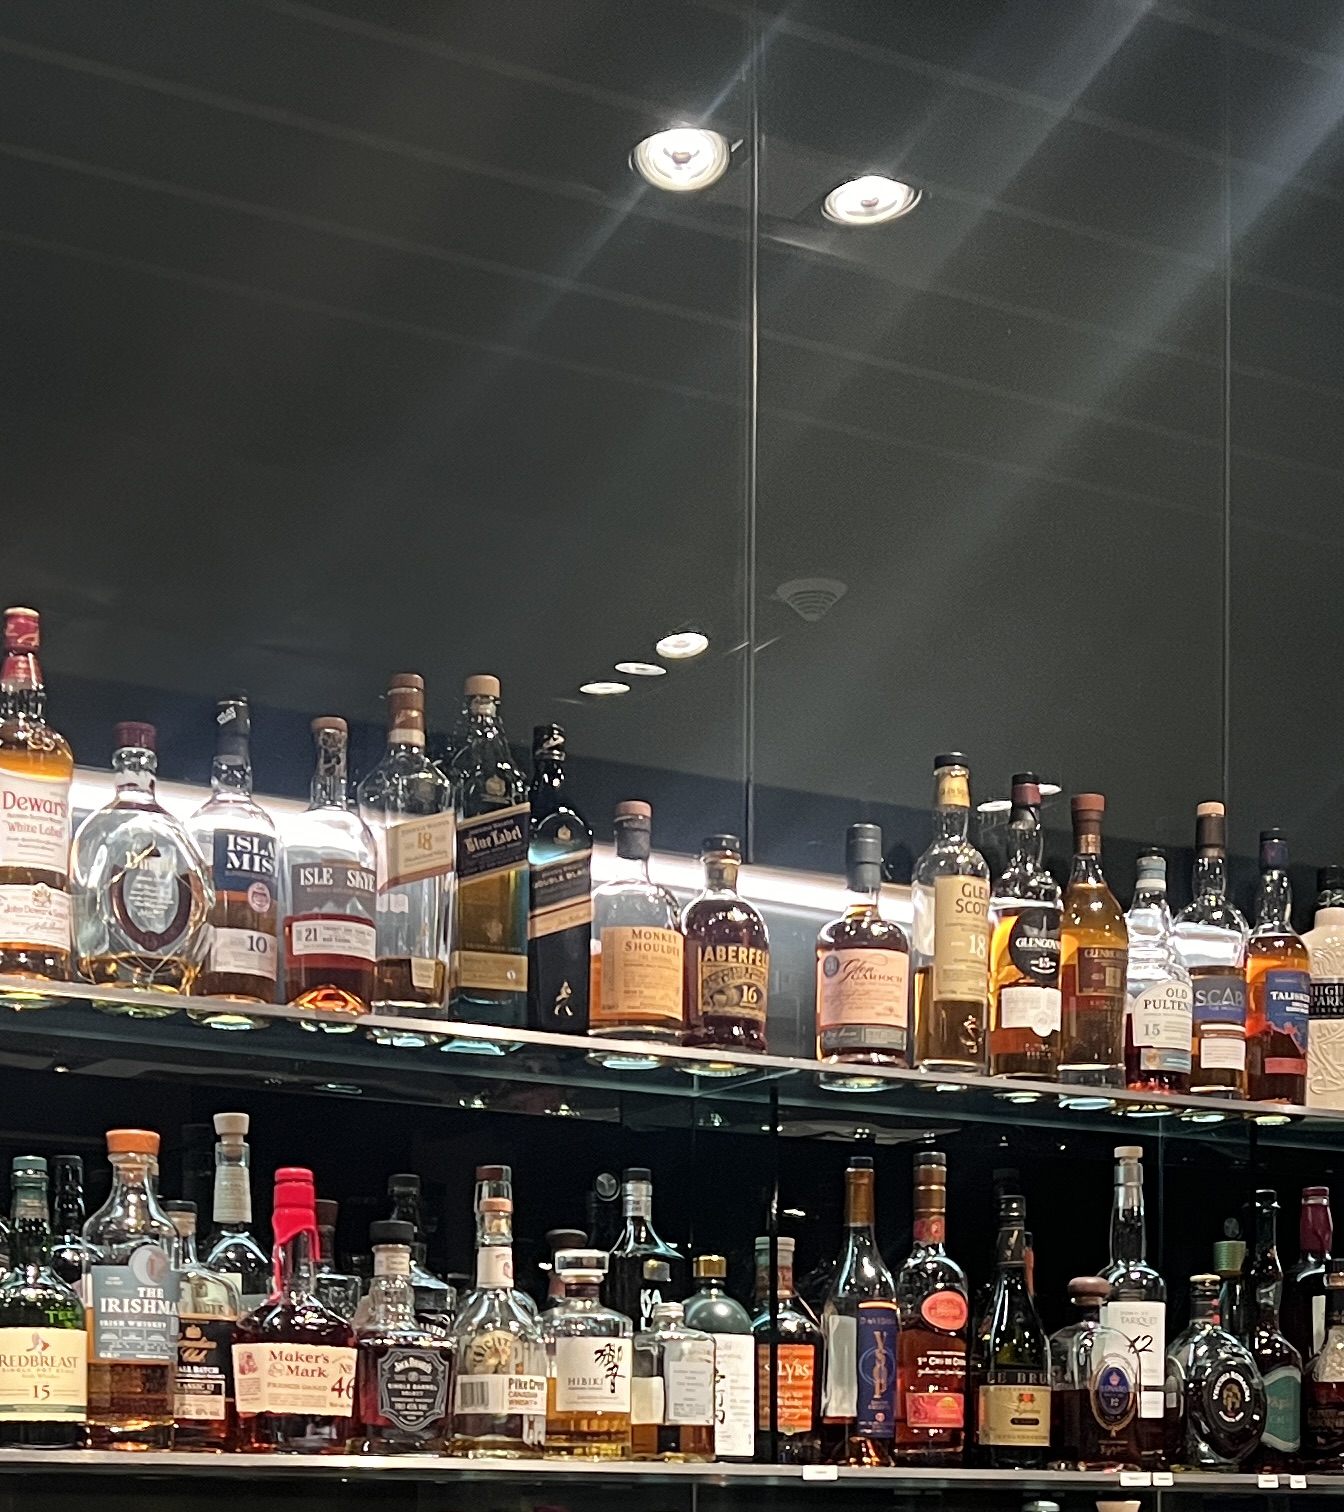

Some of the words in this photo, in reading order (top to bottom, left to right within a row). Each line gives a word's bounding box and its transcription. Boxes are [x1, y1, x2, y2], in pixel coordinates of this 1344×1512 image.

[417, 831, 433, 851] 18
[227, 853, 276, 877] MIS
[300, 867, 334, 887] ISLE
[955, 898, 988, 916] SCOT
[305, 927, 319, 943] 21
[247, 935, 268, 955] 10
[969, 933, 986, 960] 18
[741, 984, 758, 1004] 16
[1165, 987, 1188, 1000] OLD
[1143, 1022, 1161, 1037] 15
[137, 1286, 164, 1299] THE
[268, 1349, 330, 1366] Maker's
[285, 1363, 330, 1380] Mark
[330, 1375, 357, 1400] 46
[508, 1376, 527, 1390] Pike
[567, 1376, 604, 1388] HIBIKI
[32, 1384, 51, 1401] 15
